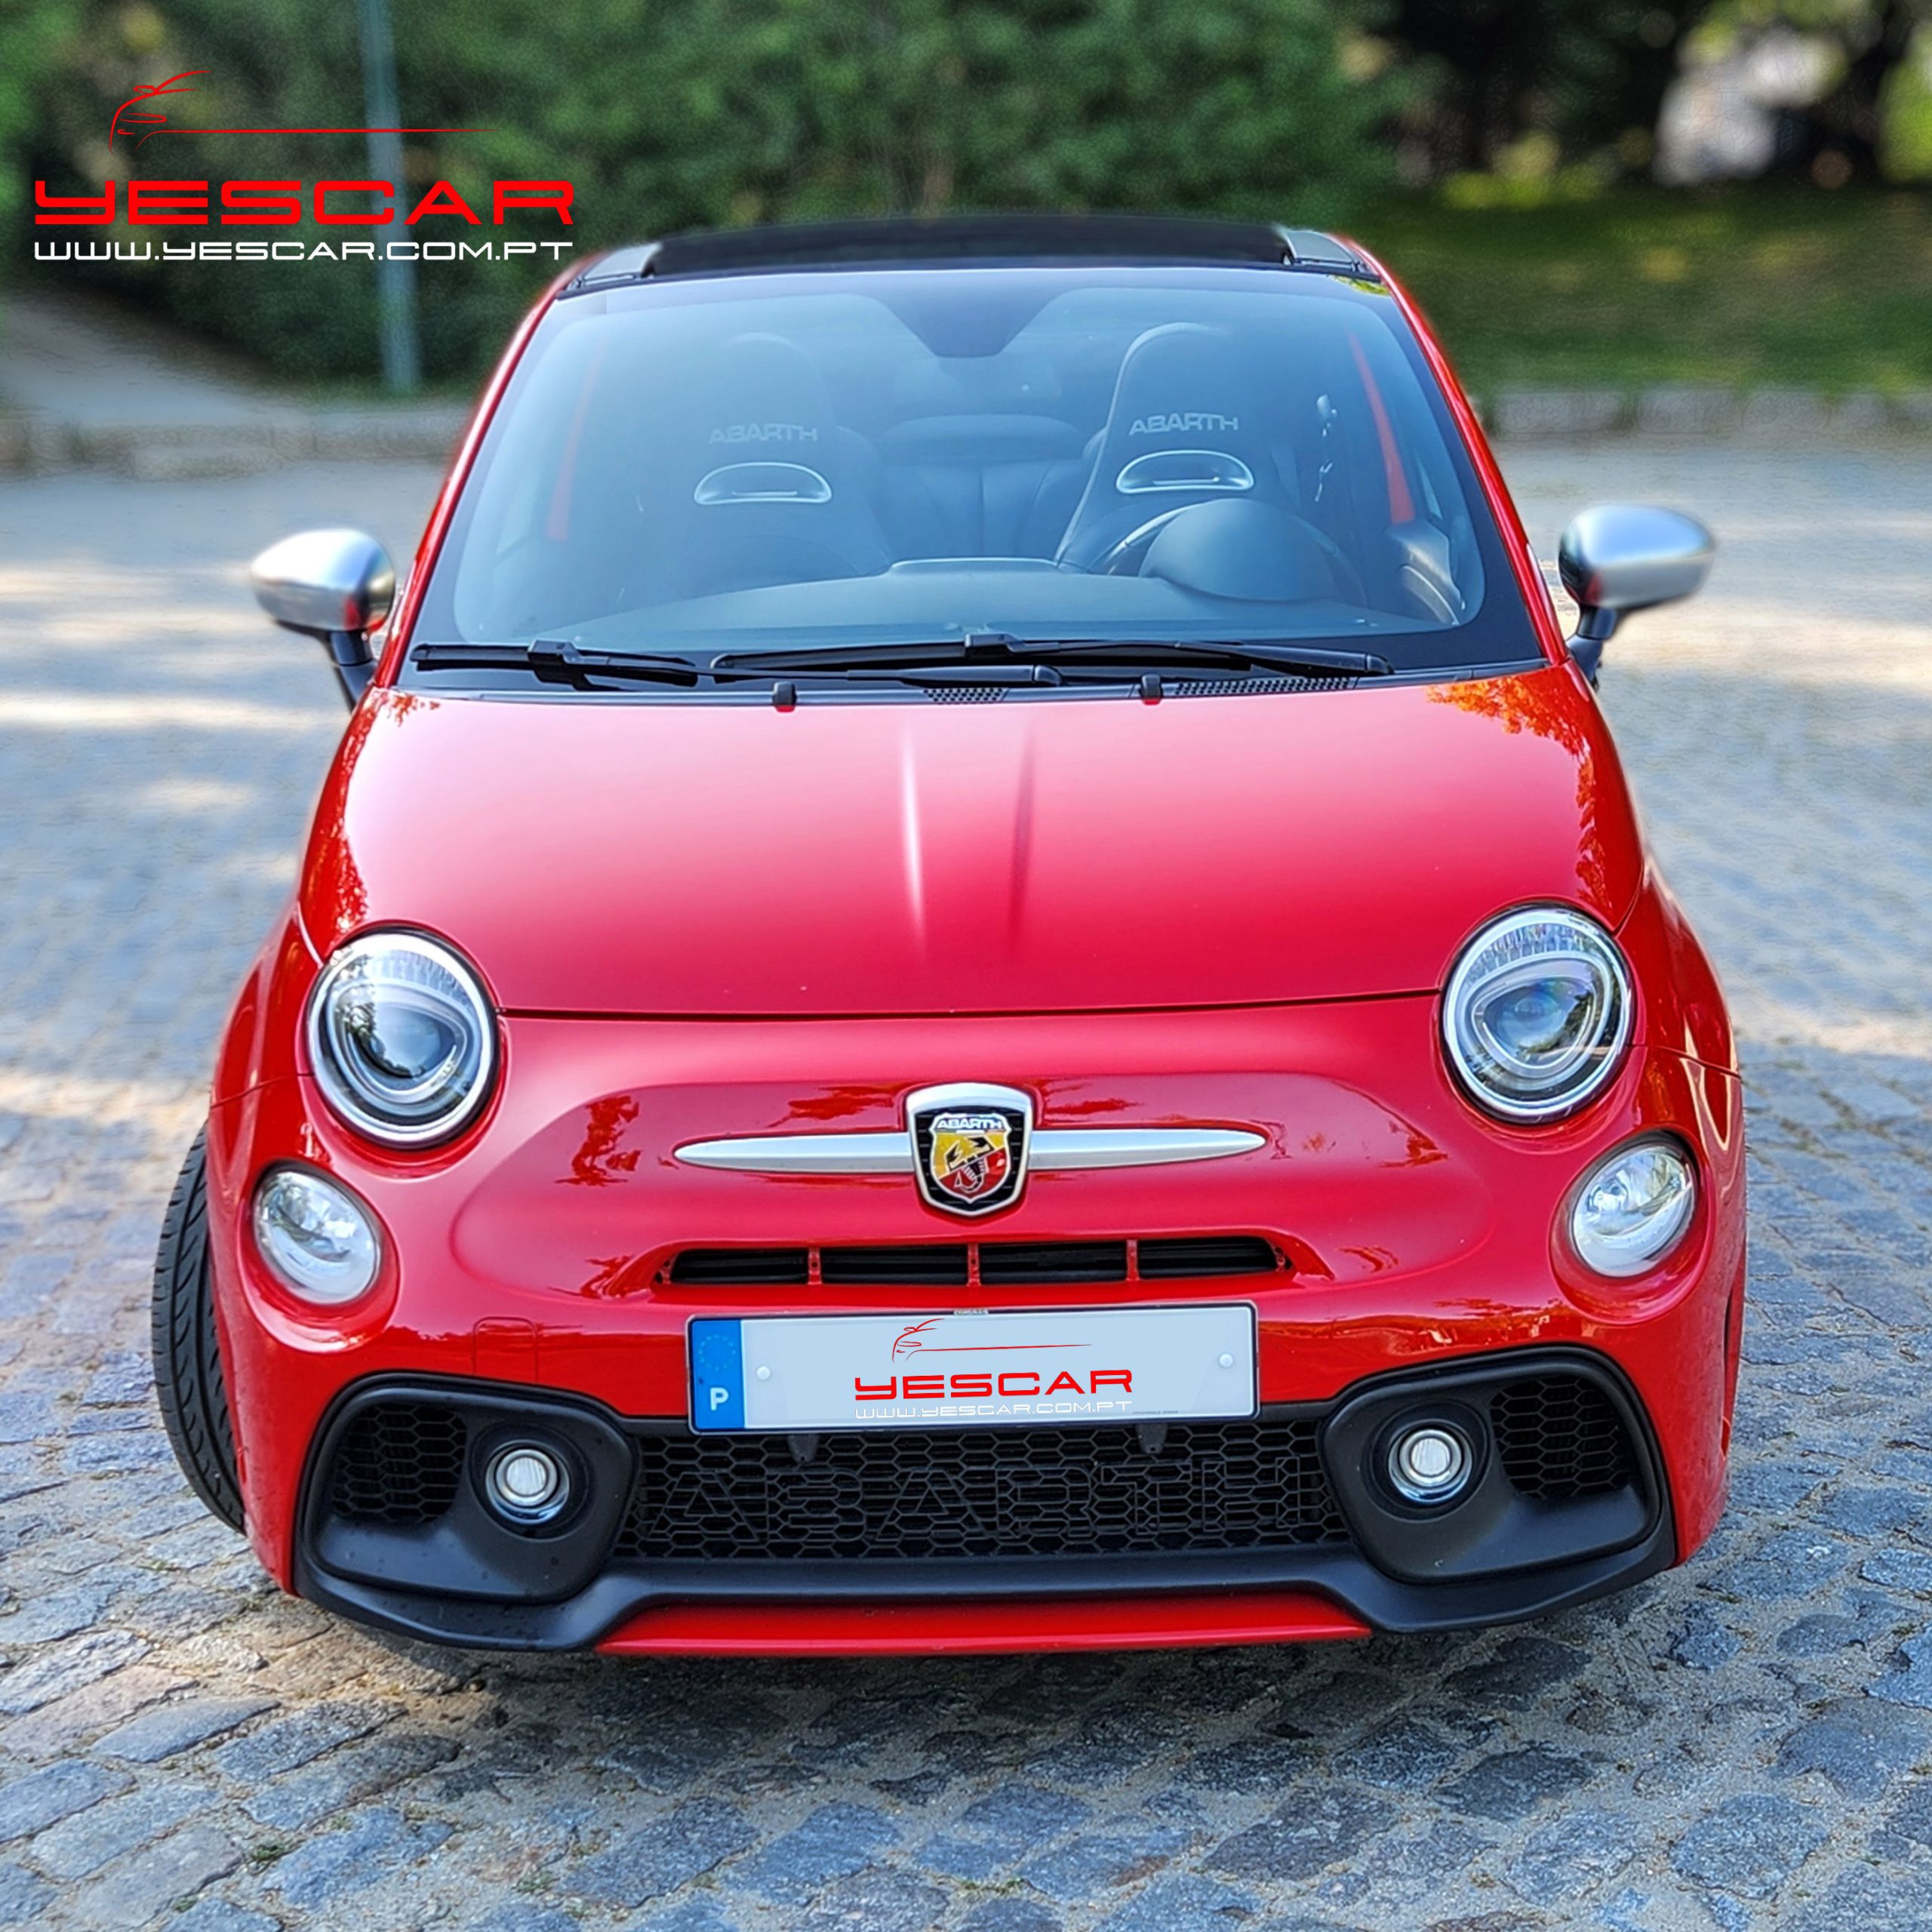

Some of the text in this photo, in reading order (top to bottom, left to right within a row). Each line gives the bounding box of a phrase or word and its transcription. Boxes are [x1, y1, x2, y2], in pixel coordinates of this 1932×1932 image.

[708, 423, 818, 444] ABARTH
[1129, 412, 1238, 435] ABARTH
[936, 1118, 1002, 1129] ABARTH
[710, 1387, 729, 1411] P
[645, 1456, 1301, 1543] ABARTH
